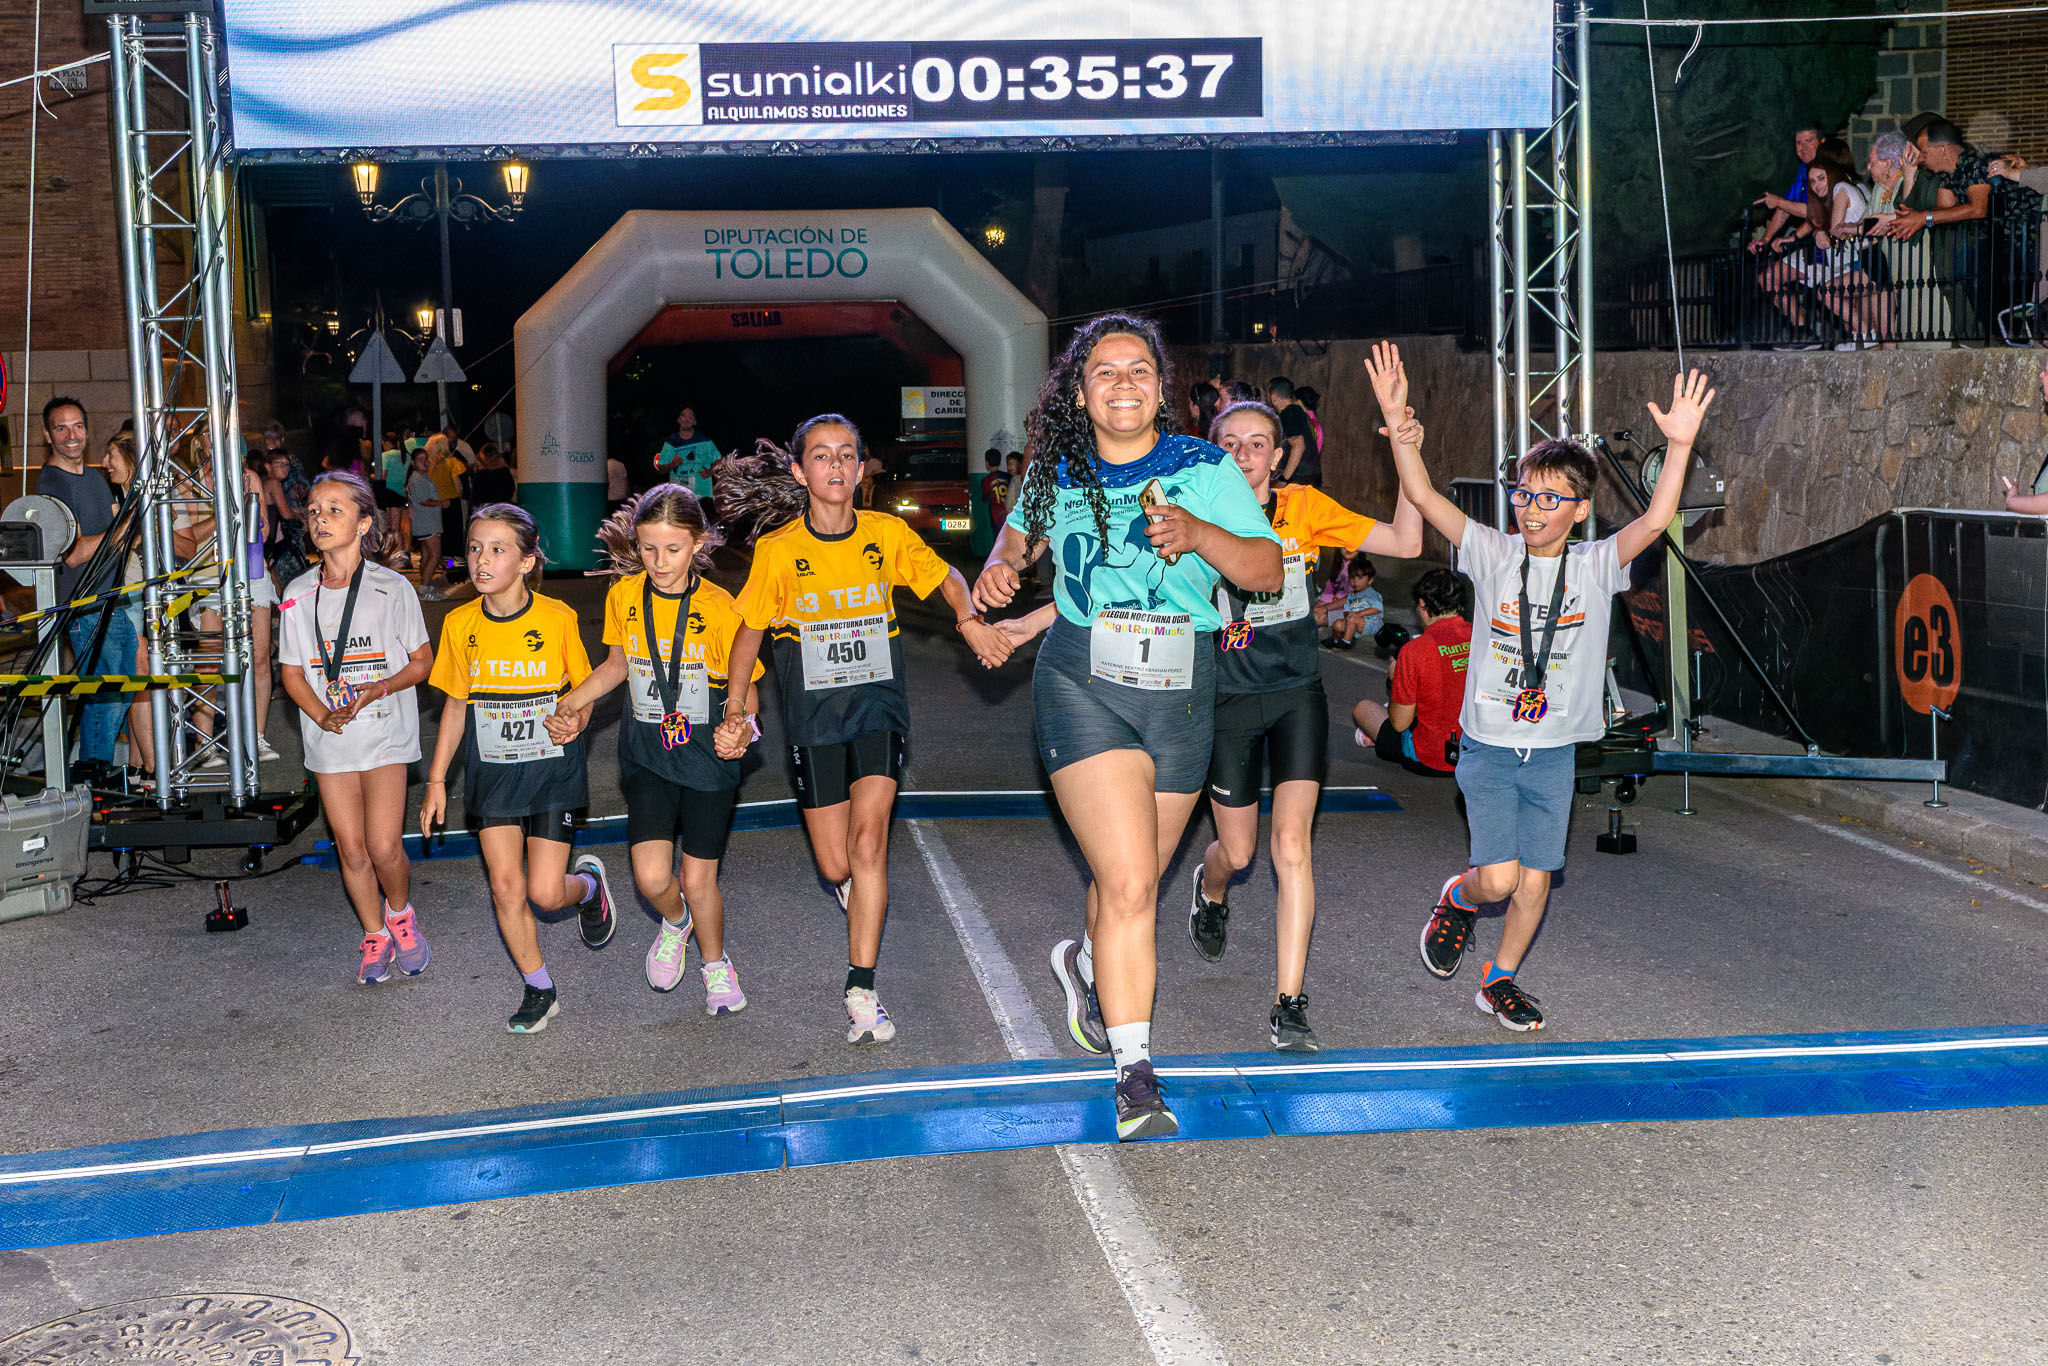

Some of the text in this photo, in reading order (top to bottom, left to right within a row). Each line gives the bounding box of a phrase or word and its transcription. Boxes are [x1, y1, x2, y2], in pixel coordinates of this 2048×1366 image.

[706, 61, 907, 97] sumialki
[911, 54, 1234, 102] 00:35:37
[707, 104, 908, 122] ALQUILAMOS SOLUCIONES
[704, 225, 868, 245] DIPUTACIÓN DE
[705, 247, 869, 279] TOLEDO
[947, 519, 967, 529] 0282
[795, 592, 820, 612] e3
[810, 622, 829, 632] LEGUA
[829, 619, 863, 631] NOCTURNA
[1106, 610, 1129, 620] LEGUA
[1130, 612, 1171, 624] NOCTURNA
[826, 639, 867, 664] 450
[1139, 637, 1151, 663] 1
[1902, 604, 1955, 688] e3
[486, 660, 547, 677] TEAM
[483, 702, 501, 710] LEGUA
[501, 700, 533, 710] NOCTURNA
[500, 719, 535, 742] 427
[15, 856, 55, 869] timingsense
